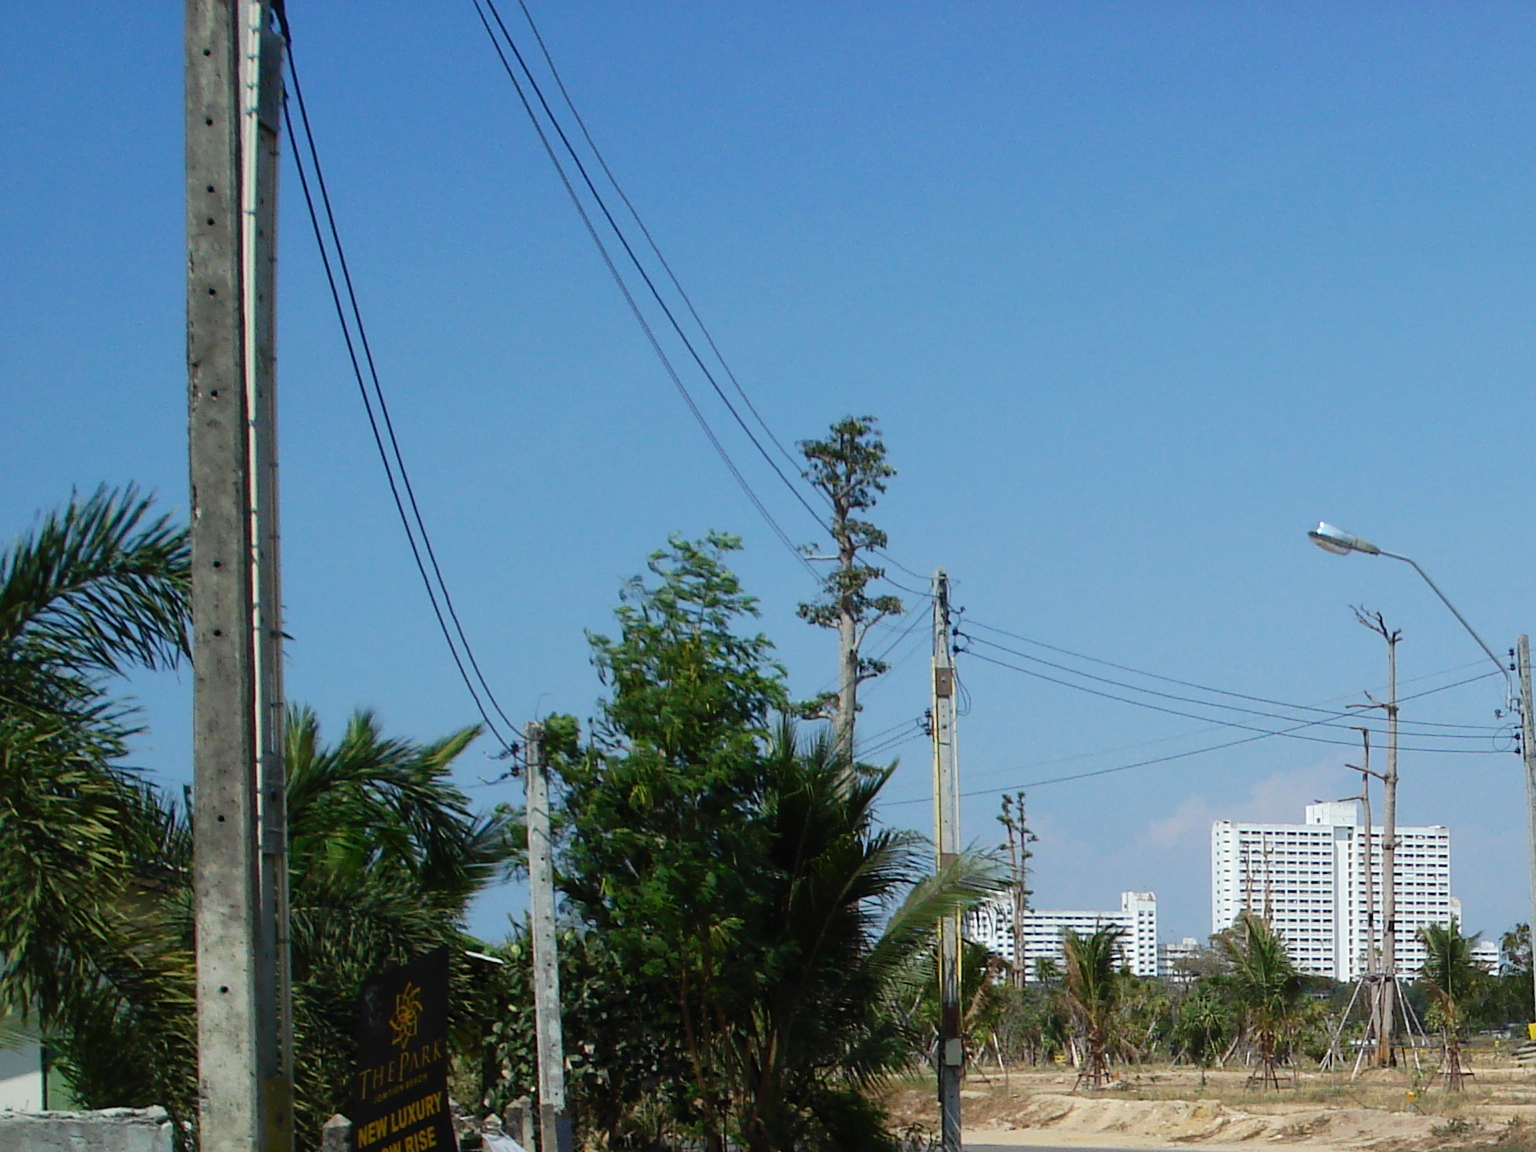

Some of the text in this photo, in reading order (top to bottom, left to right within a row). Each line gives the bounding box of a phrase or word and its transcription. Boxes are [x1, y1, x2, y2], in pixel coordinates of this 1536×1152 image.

[358, 1039, 442, 1099] THE PARK
[358, 1091, 443, 1149] NEW LUXURY
